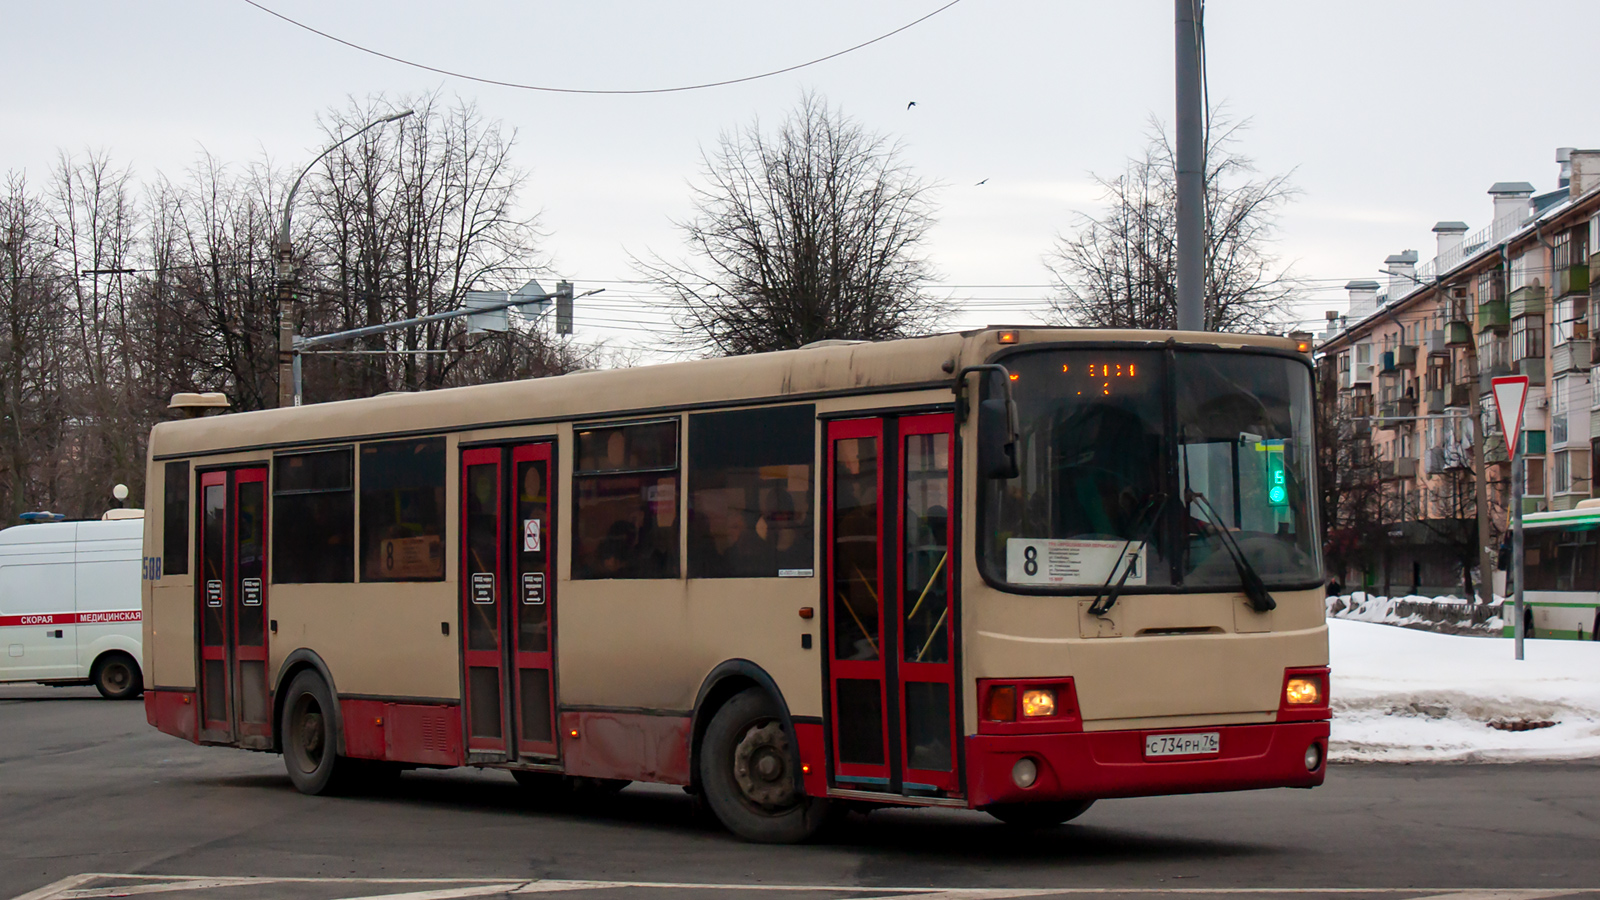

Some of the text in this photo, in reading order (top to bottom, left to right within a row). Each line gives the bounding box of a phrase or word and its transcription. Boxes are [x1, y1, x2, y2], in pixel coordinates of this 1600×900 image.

[386, 541, 394, 571] 8
[1024, 545, 1038, 576] 8
[21, 611, 141, 625] СКОРАЯ МЕДИЦИНСКАЯ
[1203, 735, 1215, 747] 76
